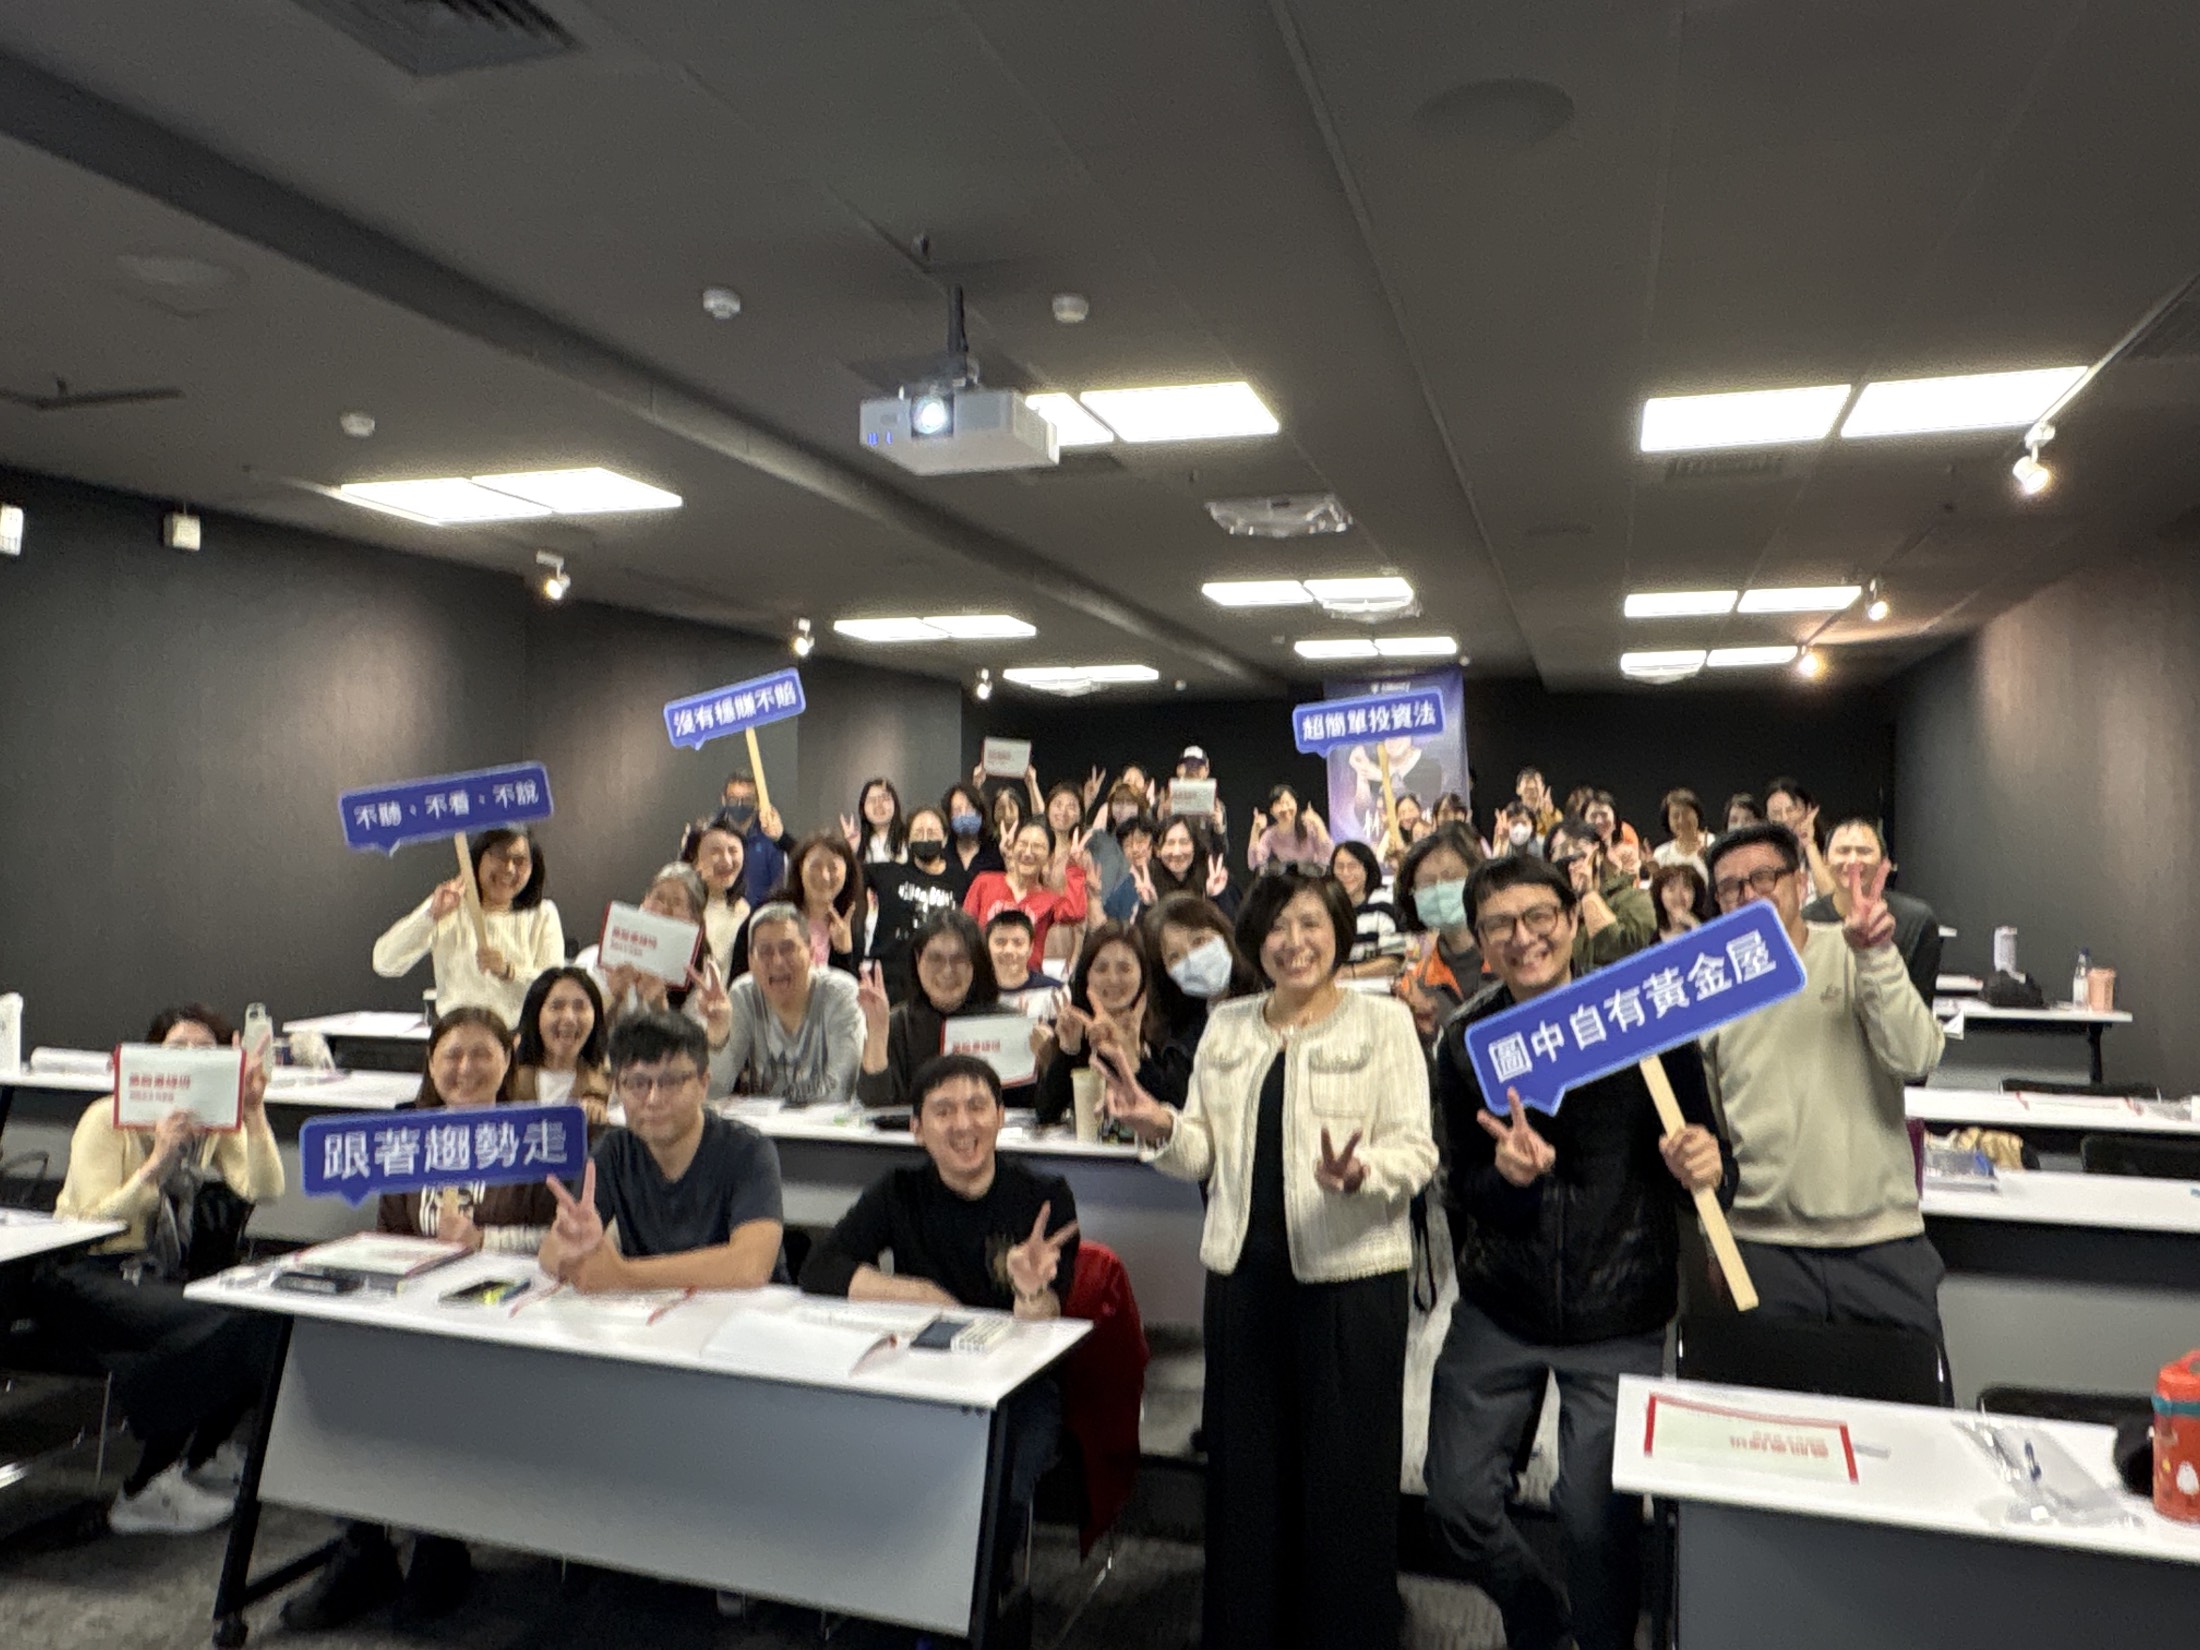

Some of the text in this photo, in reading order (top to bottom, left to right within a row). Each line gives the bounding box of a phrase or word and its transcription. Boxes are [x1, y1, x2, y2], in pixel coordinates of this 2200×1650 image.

[1302, 699, 1436, 742] 超簡單投資法
[1487, 928, 1777, 1084] 圖中自有黃金屋
[322, 1118, 568, 1180] 跟著趨勢走
